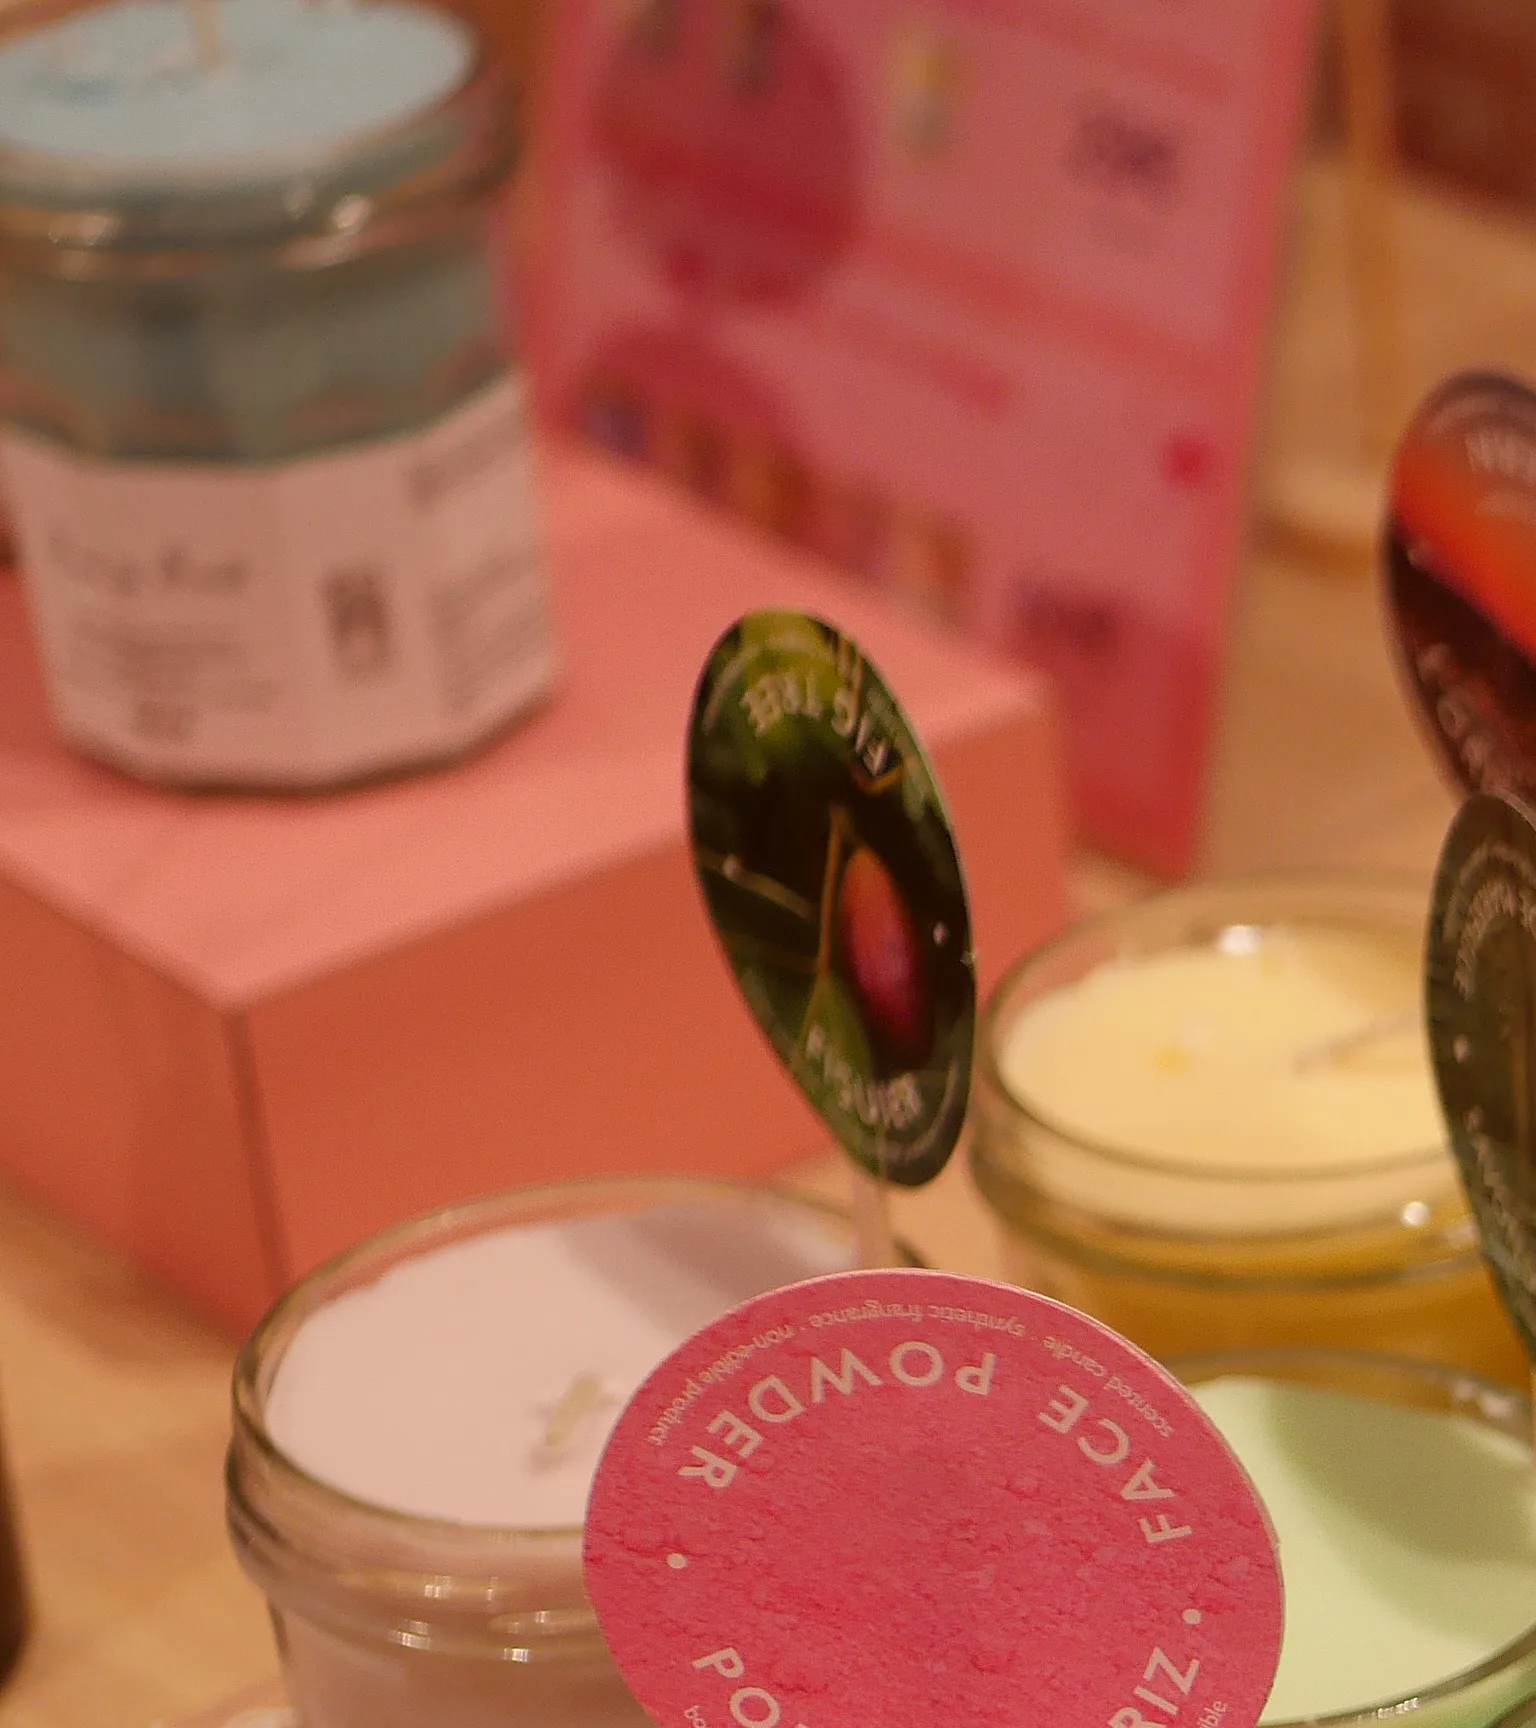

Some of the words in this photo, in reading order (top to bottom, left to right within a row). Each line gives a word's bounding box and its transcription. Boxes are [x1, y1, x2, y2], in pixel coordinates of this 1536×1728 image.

[928, 1304, 1026, 1337] synthetic
[701, 1324, 797, 1386] non-edible
[1044, 1336, 1105, 1379] candle
[647, 1379, 701, 1446] product
[678, 1341, 998, 1488] POWDER
[1107, 1376, 1174, 1437] scented
[1038, 1385, 1192, 1544] FACE
